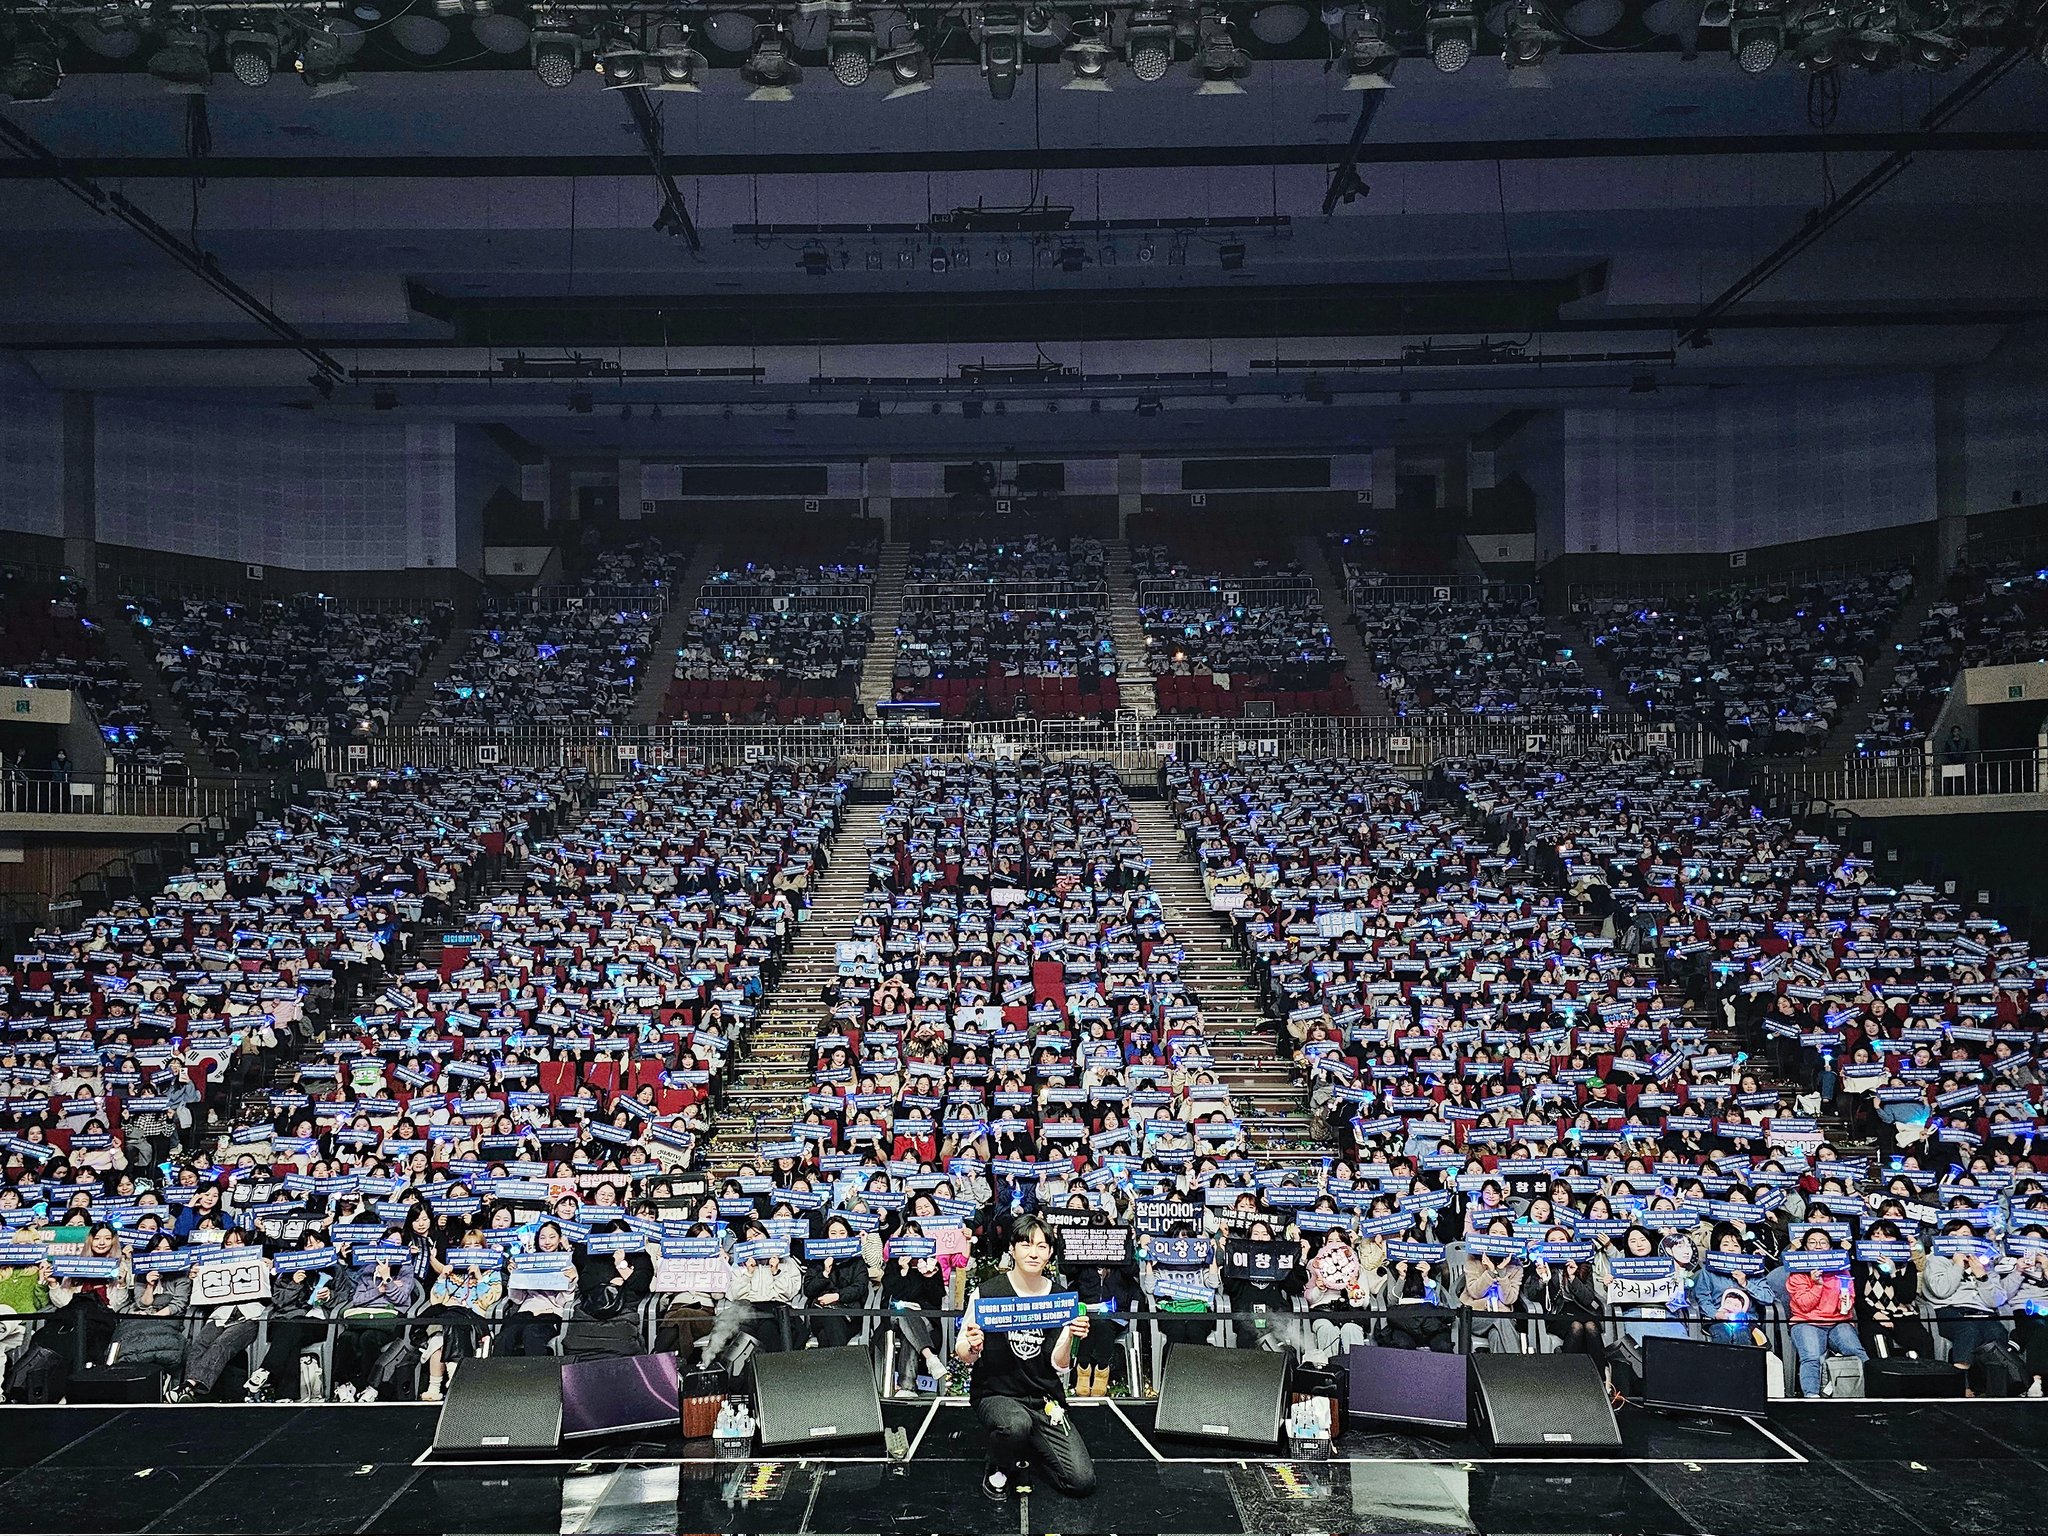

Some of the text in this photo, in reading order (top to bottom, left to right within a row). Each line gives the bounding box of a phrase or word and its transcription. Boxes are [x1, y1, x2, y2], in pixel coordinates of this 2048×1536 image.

[1733, 554, 1744, 566] F
[1226, 593, 1238, 604] H
[1436, 589, 1448, 600] G
[568, 600, 580, 609] K
[778, 600, 784, 610] J
[1260, 742, 1276, 754] 나
[481, 748, 496, 760] 마
[1516, 1182, 1546, 1193] 창섭
[1136, 1218, 1161, 1232] 누나
[202, 1265, 260, 1298] 창섭
[922, 1380, 932, 1388] 91
[354, 1464, 374, 1474] 3
[575, 1462, 592, 1470] 2
[1459, 1462, 1476, 1470] 2
[1684, 1462, 1702, 1472] 3
